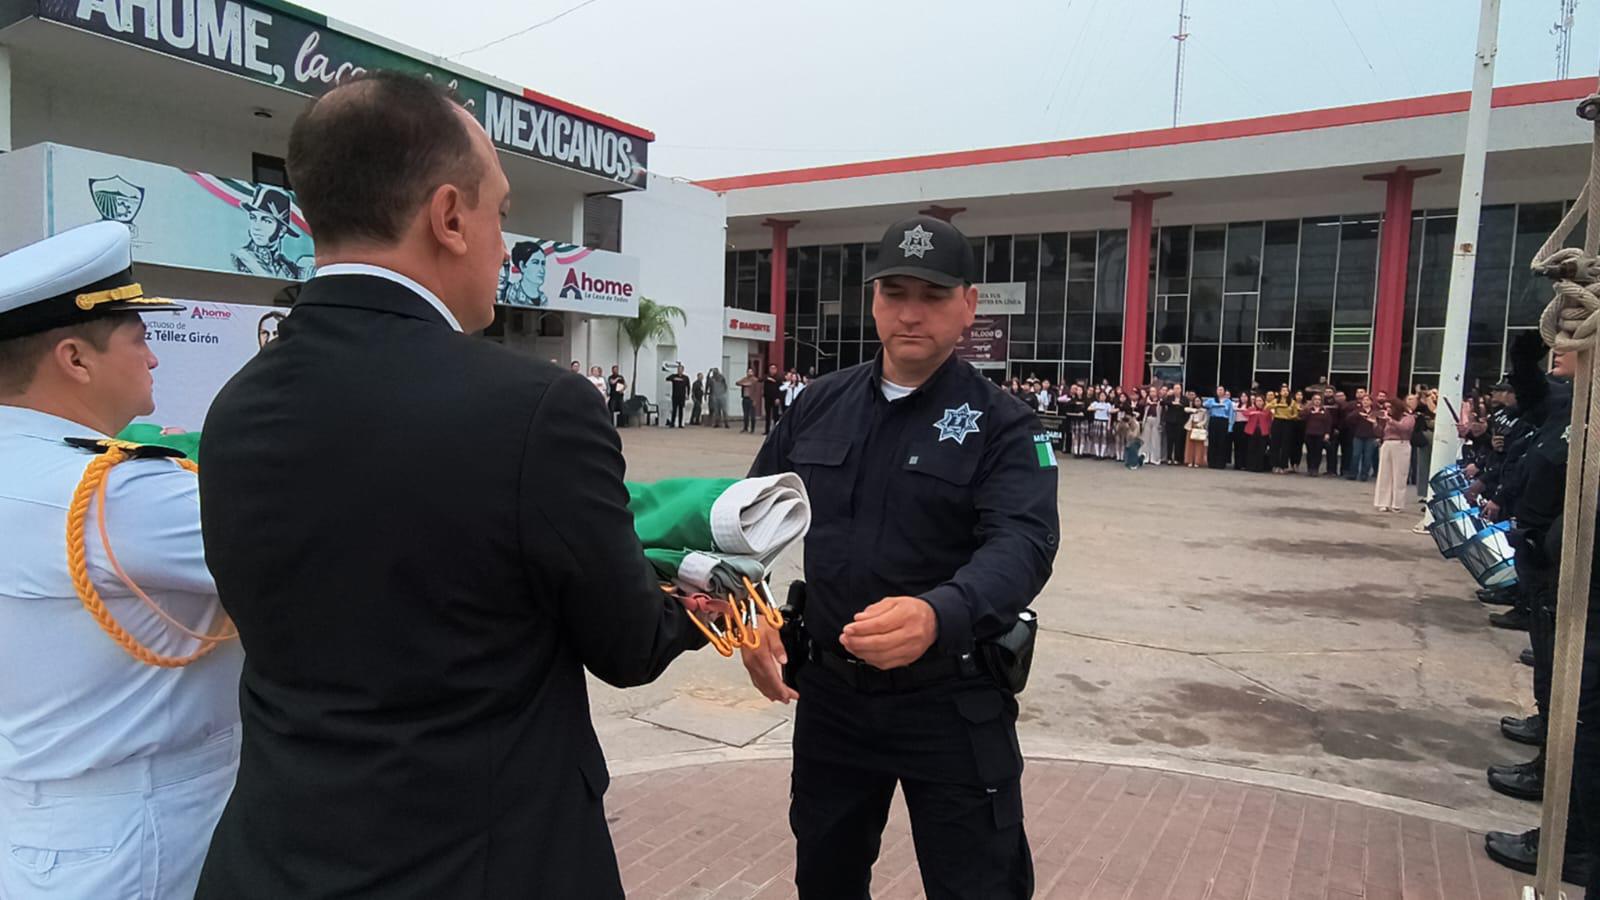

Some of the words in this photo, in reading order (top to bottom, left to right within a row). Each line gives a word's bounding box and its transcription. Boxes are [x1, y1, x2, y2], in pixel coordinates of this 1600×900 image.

[485, 90, 632, 179] MEXICANOS
[559, 267, 633, 301] Ahome
[191, 306, 231, 320] Ahome
[146, 320, 175, 329] uctuoso
[176, 322, 186, 330] de
[154, 330, 187, 343] Téllez
[189, 332, 219, 344] Girón
